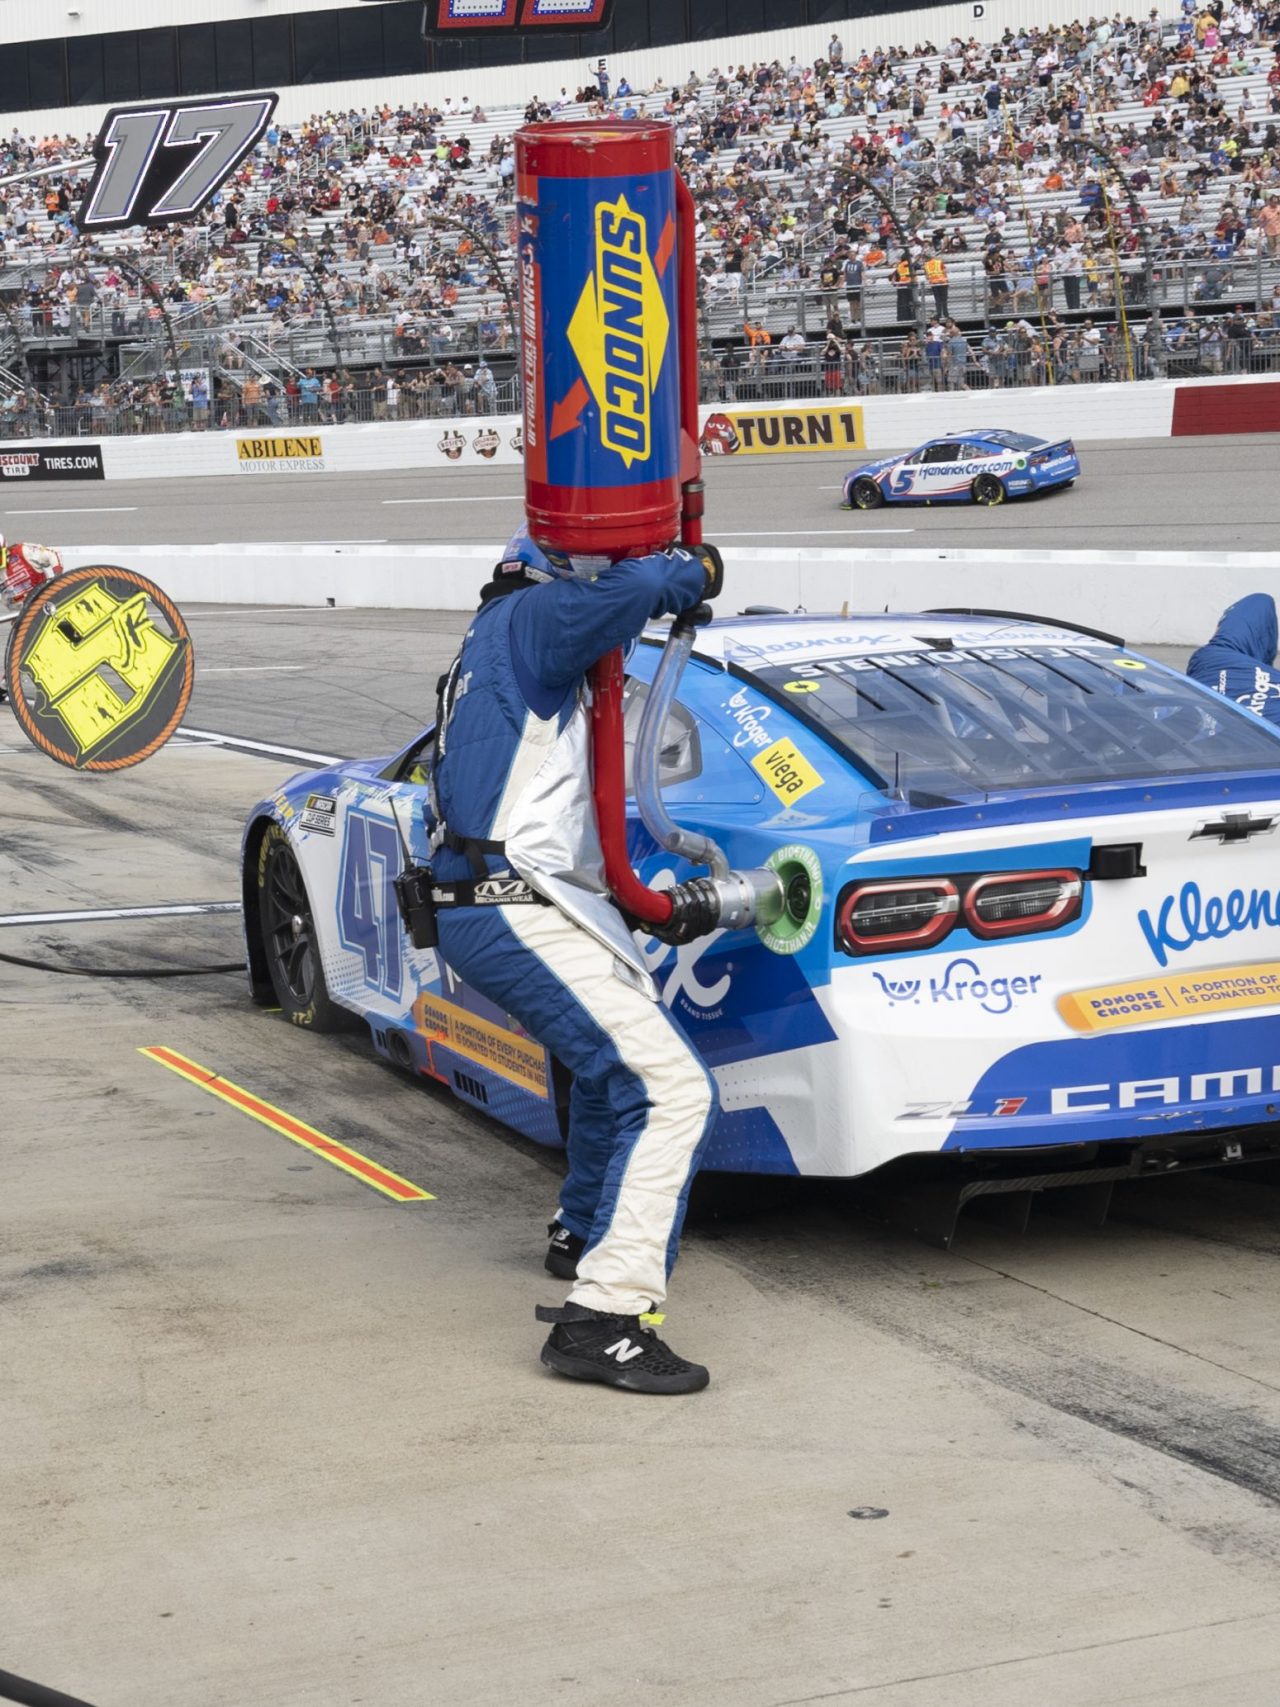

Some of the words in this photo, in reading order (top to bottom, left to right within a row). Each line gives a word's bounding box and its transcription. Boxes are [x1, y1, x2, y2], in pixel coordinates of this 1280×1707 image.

[973, 4, 985, 18] D
[86, 98, 273, 224] 17
[601, 209, 646, 453] SUNOCO
[526, 380, 536, 447] OFFICIAL
[737, 414, 834, 447] TURN
[840, 413, 856, 443] 1
[0, 453, 40, 467] SCOUNT
[238, 437, 323, 459] ABILENE
[5, 466, 28, 476] TIRE
[44, 456, 99, 470] TIRES.COM
[239, 459, 278, 472] MOTOR
[280, 458, 326, 471] EXPRESS
[918, 460, 1014, 480] HendrickCars.com
[893, 470, 917, 494] 5
[789, 648, 1044, 678] STENHOUSE
[1052, 645, 1098, 660] JR
[733, 705, 773, 748] Kroger
[765, 750, 804, 794] viega
[337, 806, 403, 1003] 47
[929, 958, 1042, 1015] Kroger
[1180, 985, 1189, 995] A
[1192, 978, 1257, 995] PORTION
[1260, 974, 1278, 985] OF
[1184, 995, 1194, 1005] IS
[1195, 987, 1266, 1004] DONATED
[1090, 989, 1159, 1009] DONORS
[1097, 999, 1165, 1019] CHOOSE
[701, 1008, 724, 1021] TISSUE
[461, 1023, 487, 1041] PORTION
[496, 1038, 517, 1057] EVERY
[462, 1038, 489, 1058] DONATED
[498, 1055, 527, 1077] STUDENTS
[895, 1096, 1028, 1122] ZL1
[604, 1337, 644, 1364] N
